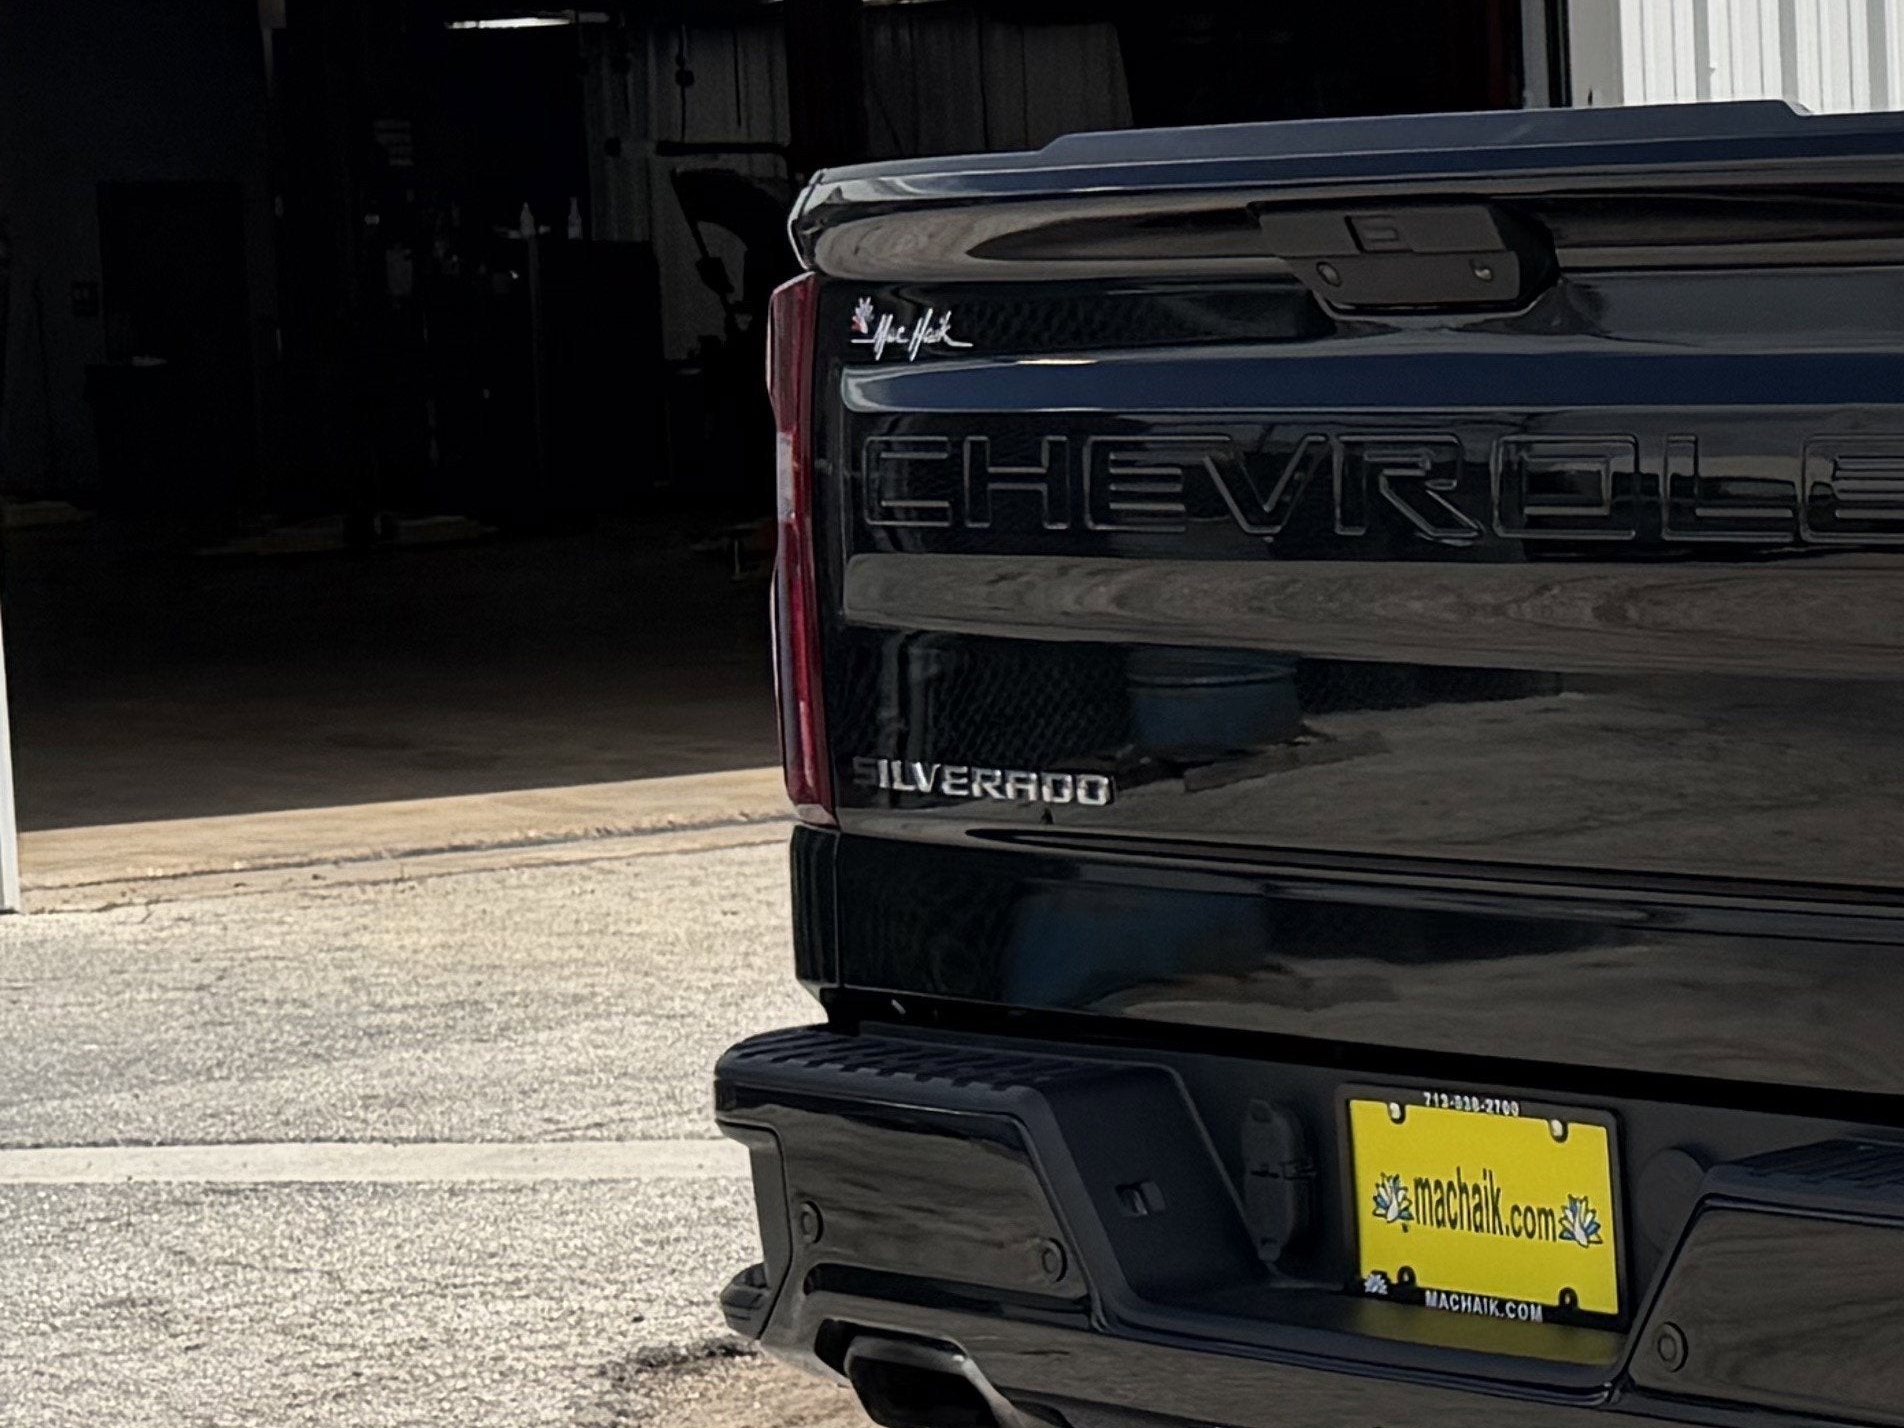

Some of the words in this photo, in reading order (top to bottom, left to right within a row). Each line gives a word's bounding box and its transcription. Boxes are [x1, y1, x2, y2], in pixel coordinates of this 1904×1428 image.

[852, 756, 1113, 806] SILVERADO
[1413, 1166, 1557, 1242] machaik.com
[1424, 1290, 1544, 1323] MACHAIK.COM
